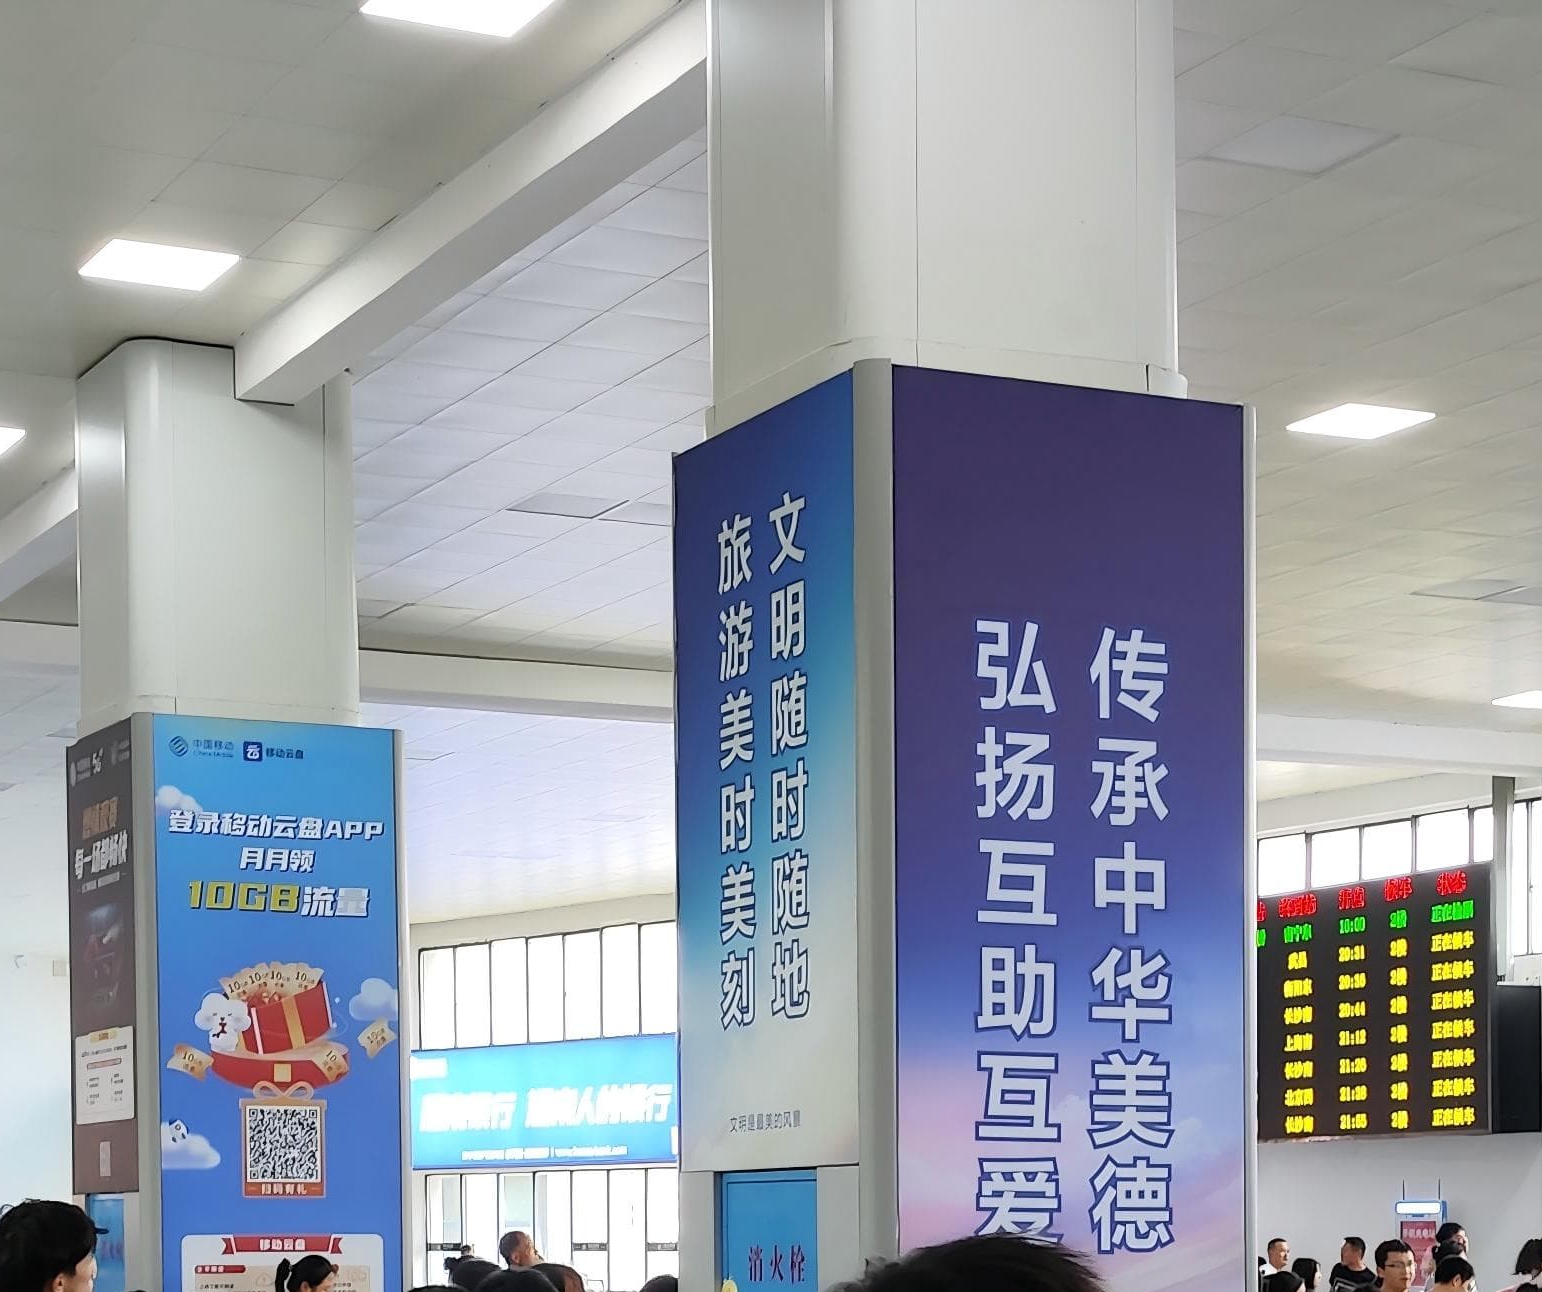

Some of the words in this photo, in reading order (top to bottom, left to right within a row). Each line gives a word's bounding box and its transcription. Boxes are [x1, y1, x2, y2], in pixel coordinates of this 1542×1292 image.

[169, 809, 384, 840] 登录移动云盘APP
[239, 847, 315, 873] 月月领
[266, 748, 304, 759] 移动云盘
[716, 512, 757, 1034] 旅游美时美刻
[767, 490, 811, 1023] 文明随时随地
[973, 616, 1061, 1245] 弘扬互助互爱
[1088, 624, 1173, 1254] 传承中华美德
[748, 1244, 806, 1285] 消火栓
